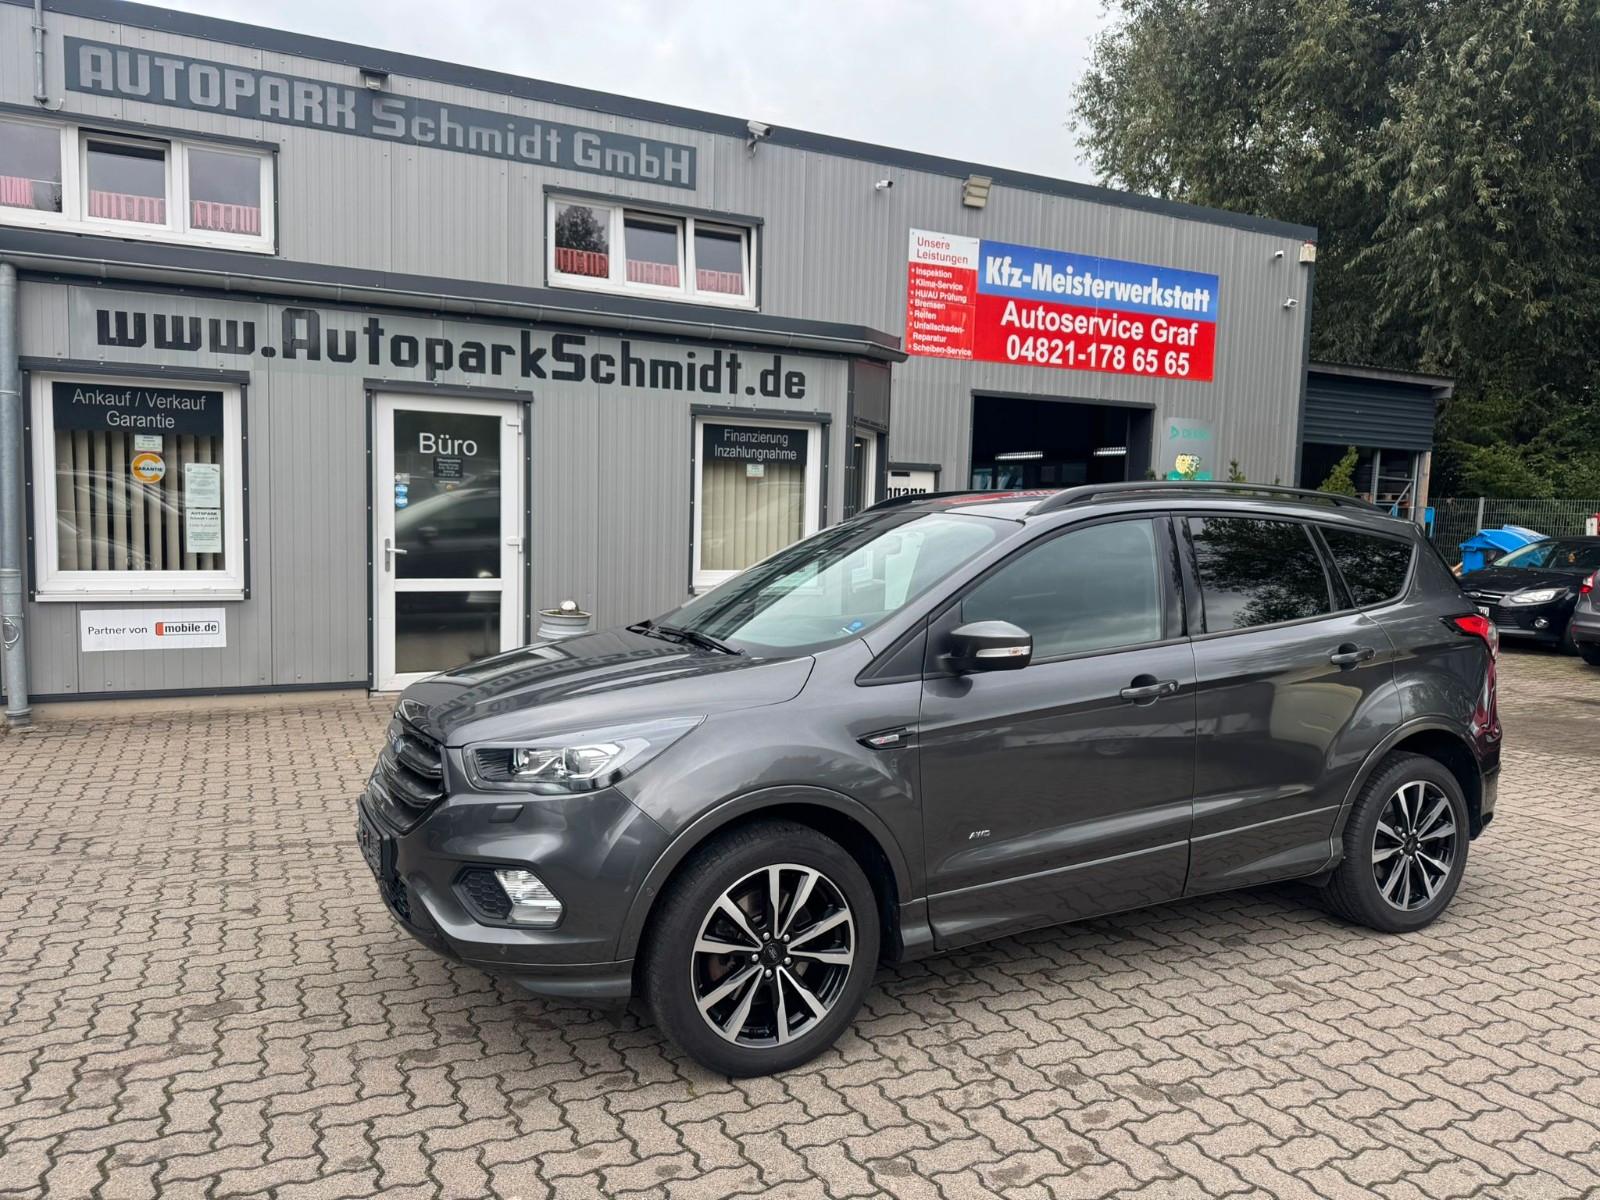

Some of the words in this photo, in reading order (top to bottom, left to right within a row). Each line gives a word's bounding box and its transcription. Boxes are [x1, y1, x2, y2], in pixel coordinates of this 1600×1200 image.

[79, 45, 356, 130] AUTOPARK
[372, 99, 562, 163] Schmidt
[573, 130, 690, 184] GmbH
[917, 236, 951, 250] Unsere
[917, 249, 969, 265] Leistungen
[916, 267, 953, 279] Inspektion
[915, 279, 963, 292] Klima-Service
[985, 256, 1210, 313] Kfz-Meisterwerkstatt
[915, 289, 938, 299] HU/AU
[940, 292, 967, 304] Prüfung
[914, 300, 946, 310] Bremsen
[914, 310, 937, 320] Reifen
[913, 321, 965, 334] Unfallschaden-
[1000, 300, 1144, 340] Autoservice
[1151, 318, 1199, 347] Graf
[913, 331, 947, 343] Reparatur
[96, 308, 807, 400] www.AutoparkSchmidt.de
[913, 343, 972, 356] Scheiben-Service
[1006, 335, 1126, 370] 04821-178
[1132, 348, 1159, 374] 65
[1164, 351, 1190, 376] 65
[72, 388, 131, 407] Ankauf
[145, 391, 206, 411] Verkauf
[106, 411, 175, 429] Garantie
[418, 432, 478, 456] Büro
[723, 429, 789, 446] Finanzierung
[714, 444, 797, 461] Inzahlungnahme
[88, 625, 126, 636] Partner
[129, 626, 148, 635] von
[164, 622, 217, 634] mobile.de
